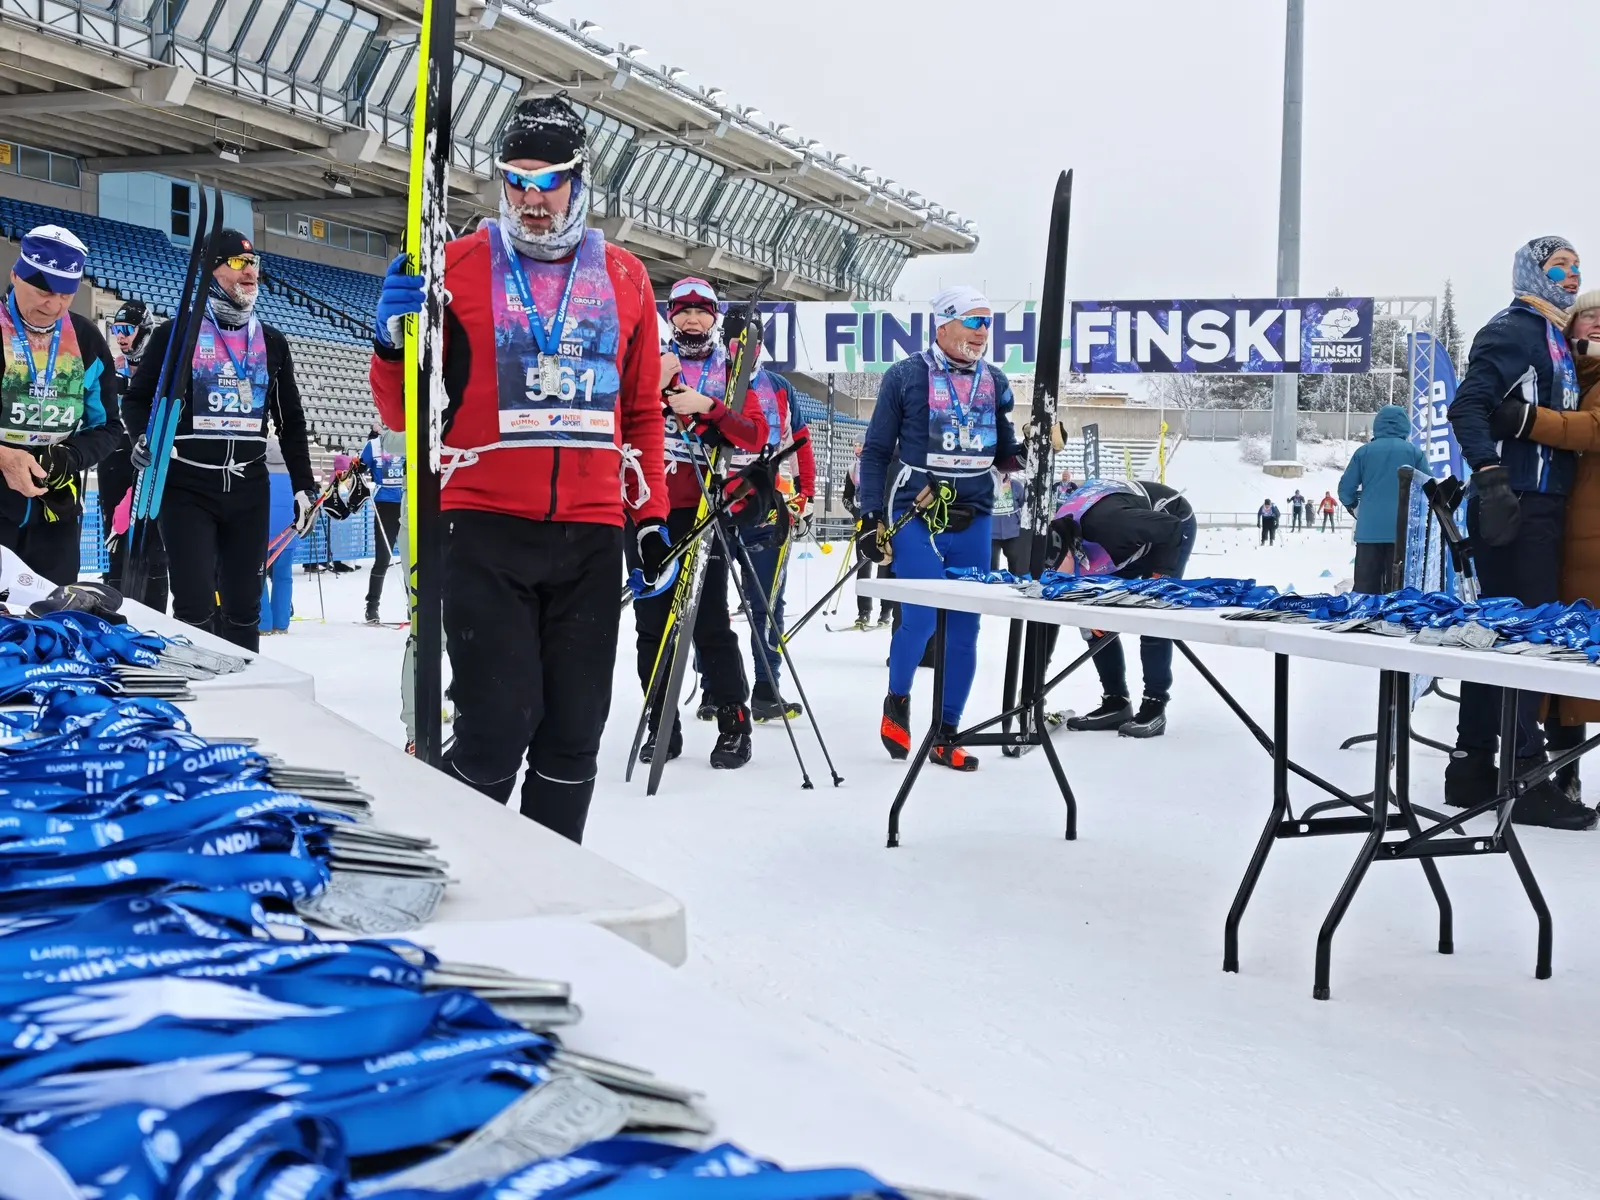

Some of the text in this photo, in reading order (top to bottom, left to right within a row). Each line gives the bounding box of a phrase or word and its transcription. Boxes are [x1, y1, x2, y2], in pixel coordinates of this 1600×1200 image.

[298, 225, 308, 236] A3
[826, 313, 1036, 362] FINH
[1076, 309, 1301, 364] FINSKI
[1311, 345, 1362, 357] FINSKI
[525, 367, 595, 401] 561
[10, 402, 76, 427] 5224
[511, 419, 539, 427] RUMMO
[942, 432, 984, 452] 84
[129, 470, 144, 527] SALOMON
[82, 760, 125, 771] FINLAND
[183, 746, 248, 773] HIIHTO
